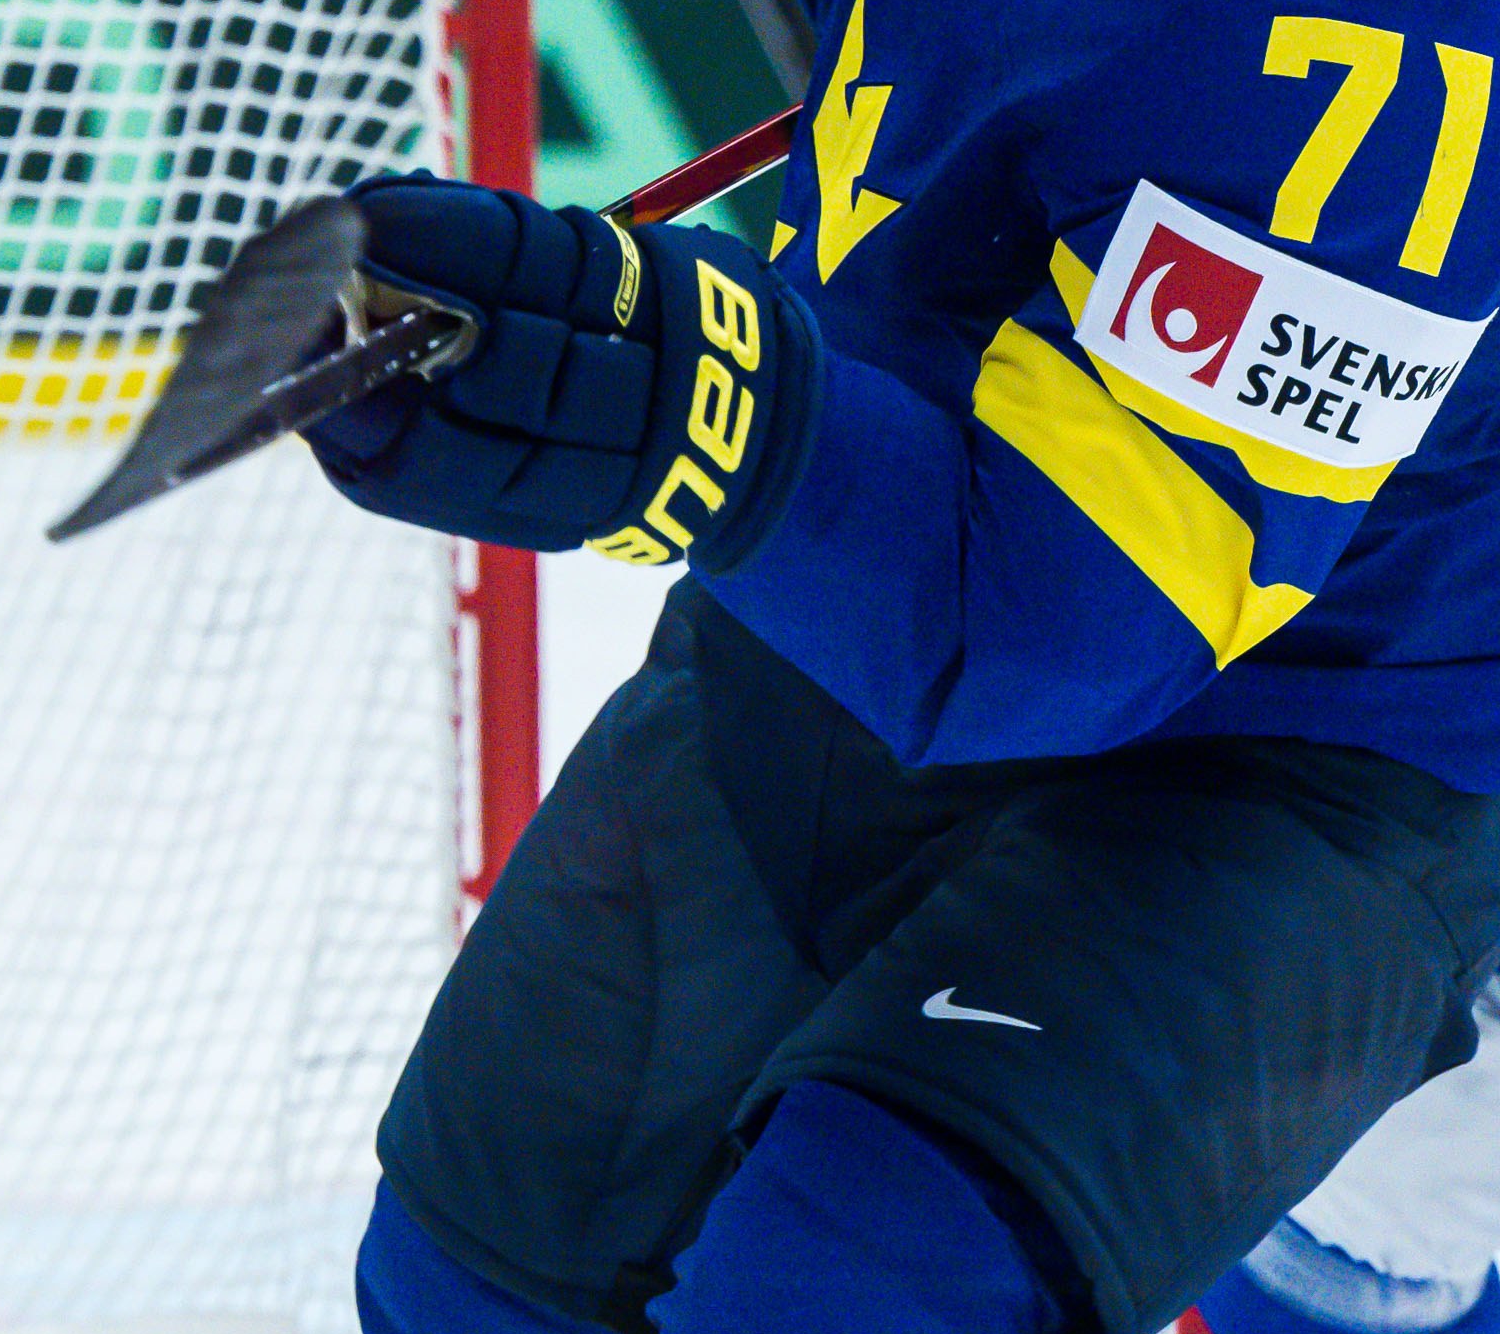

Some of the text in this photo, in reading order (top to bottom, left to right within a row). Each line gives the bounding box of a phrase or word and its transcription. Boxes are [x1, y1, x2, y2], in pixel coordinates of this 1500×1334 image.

[1262, 15, 1495, 278] 71
[1260, 313, 1460, 401] SVENSKA
[1236, 363, 1363, 445] SPEL
